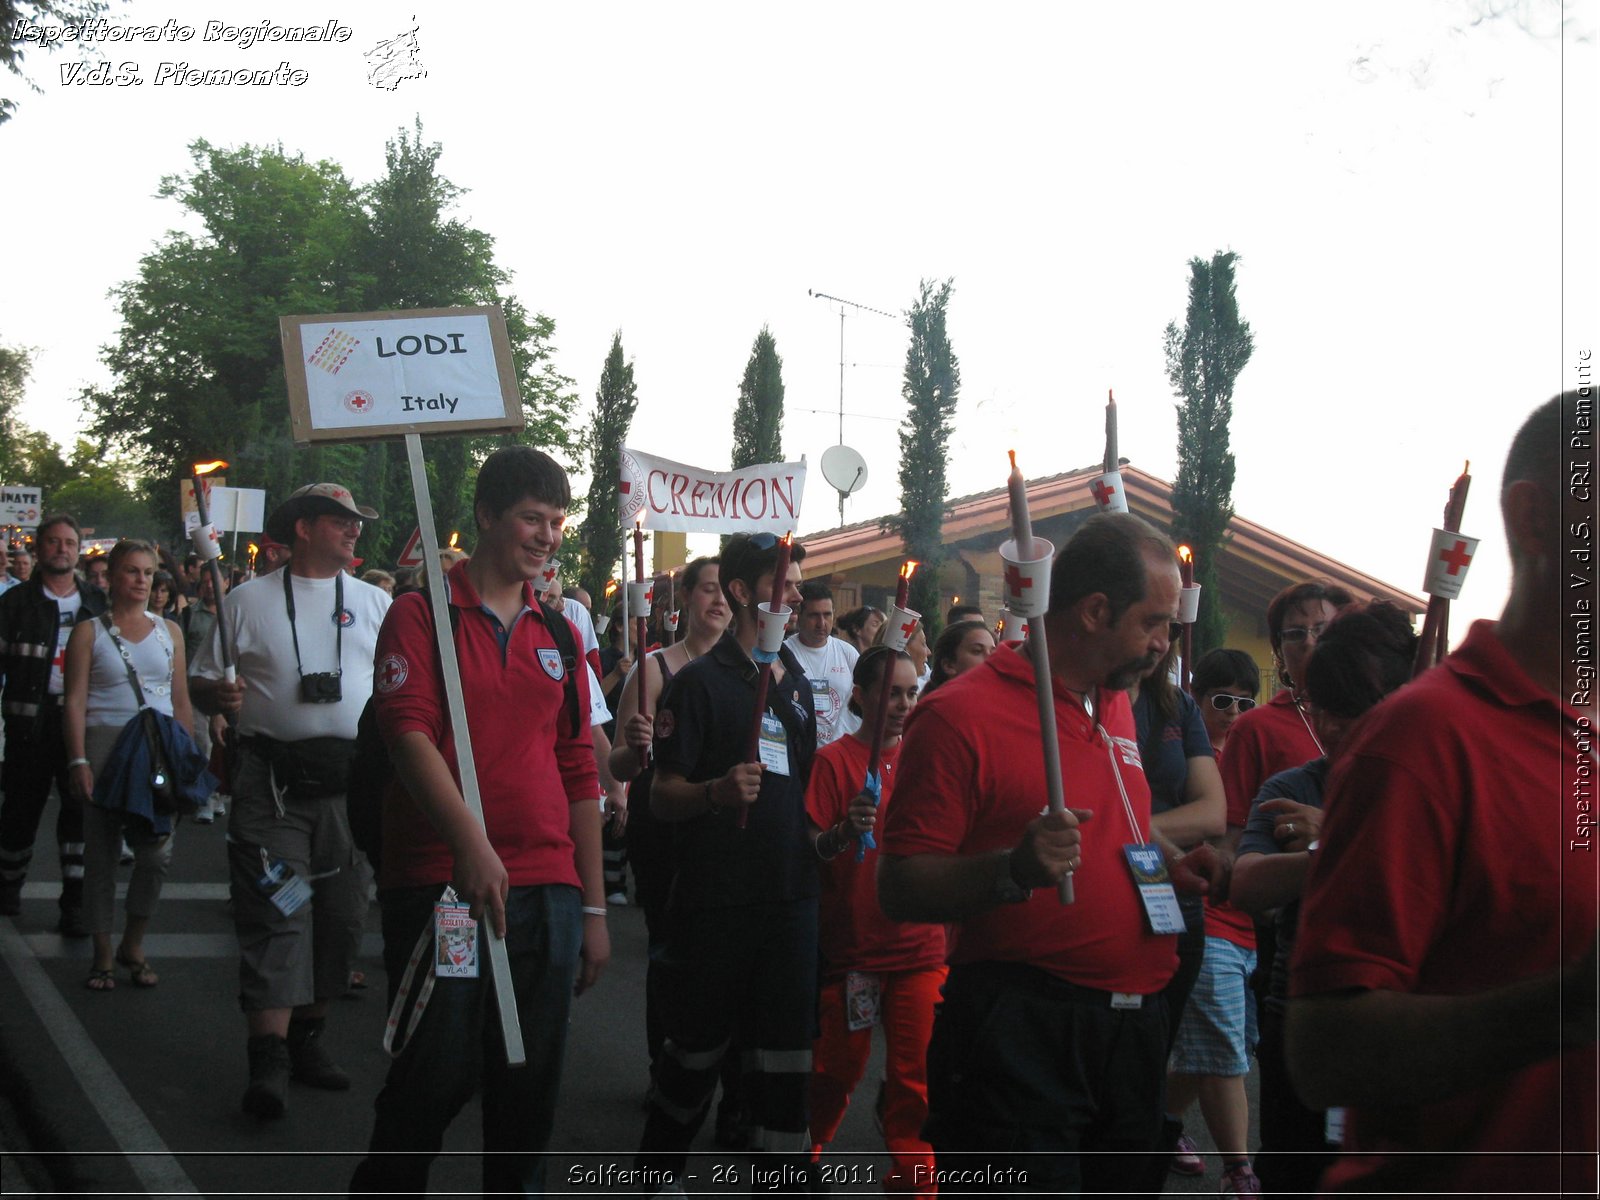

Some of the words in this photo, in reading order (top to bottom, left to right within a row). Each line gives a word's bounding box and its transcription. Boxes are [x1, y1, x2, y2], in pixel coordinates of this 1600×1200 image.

[376, 333, 468, 358] LODI
[401, 393, 459, 414] Italy
[0, 493, 38, 505] INATE
[647, 469, 801, 520] CREMON
